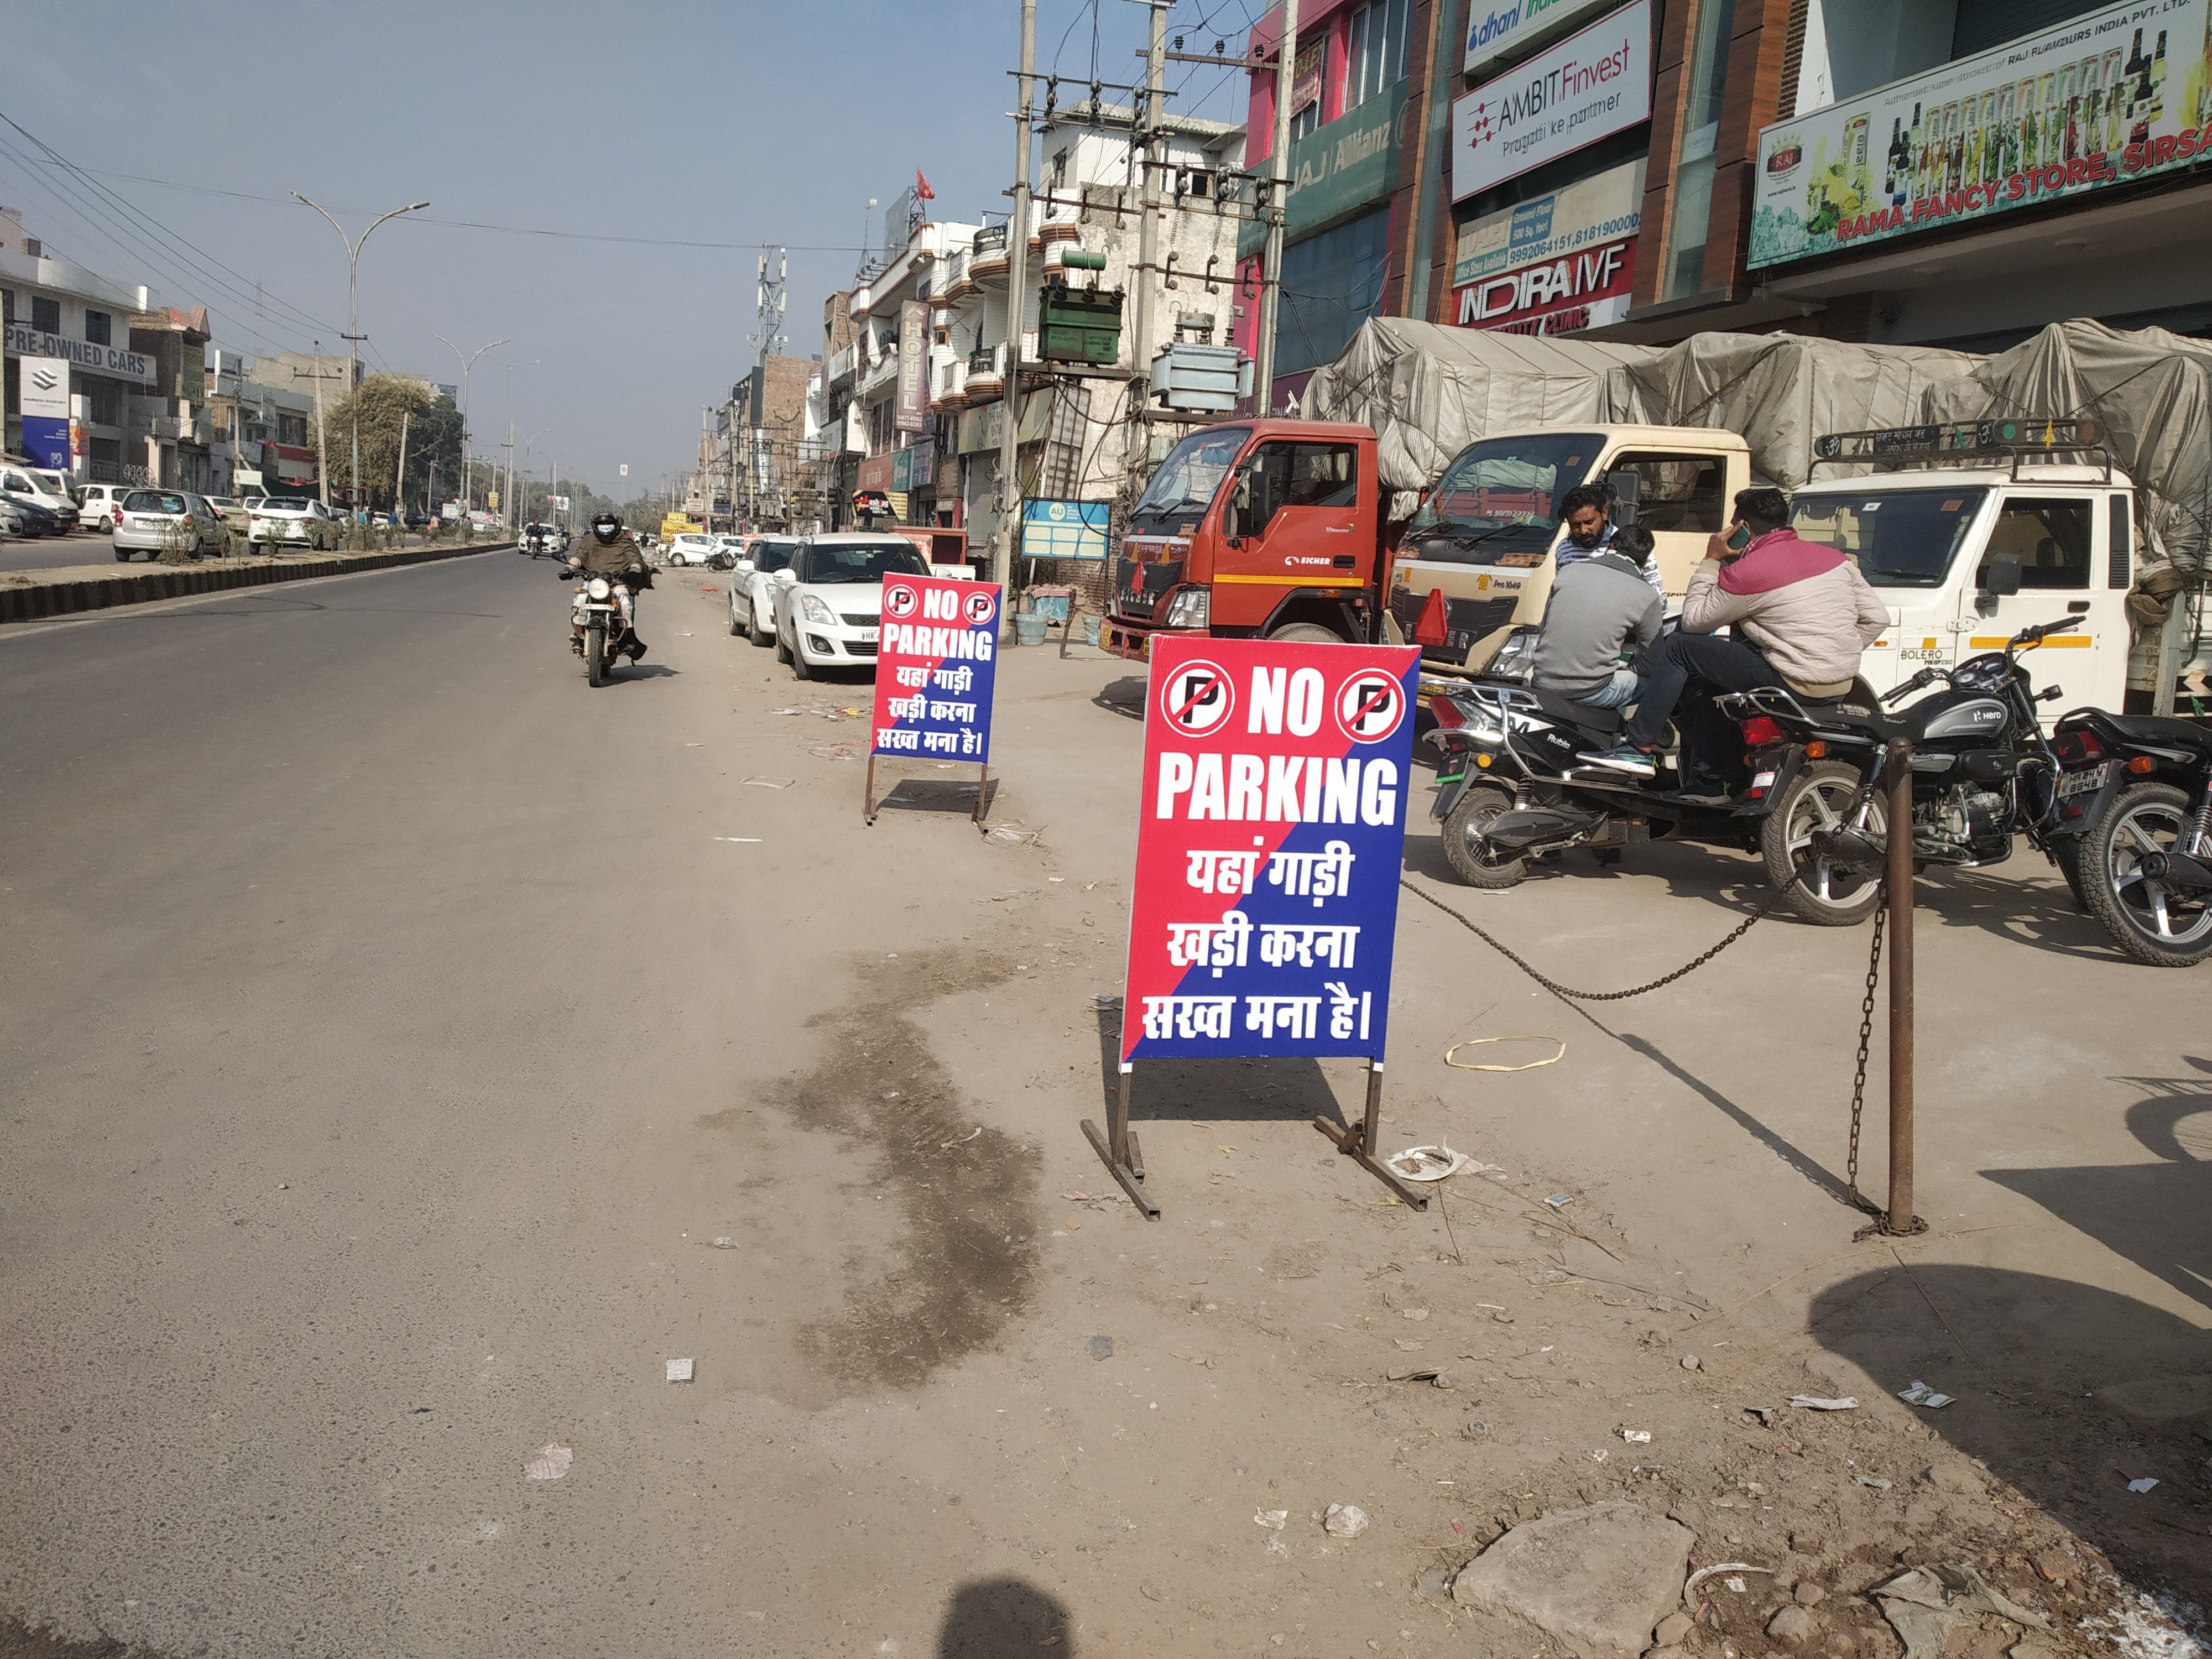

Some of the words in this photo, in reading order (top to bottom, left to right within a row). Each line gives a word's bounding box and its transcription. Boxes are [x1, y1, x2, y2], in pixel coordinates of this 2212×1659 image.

[2008, 48, 2031, 65] RAJ
[2095, 16, 2128, 36] INDIA
[1498, 69, 1561, 132] AMBIT
[1561, 38, 1630, 102] Finvest
[1333, 120, 1392, 175] Allianz
[1551, 119, 1565, 137] ke
[1775, 152, 1794, 168] RAJ
[1837, 205, 1905, 242] RAMA
[1911, 179, 2003, 223] FANCY
[2006, 152, 2116, 201] STORE,
[1458, 260, 1573, 325] INDIRA
[1575, 244, 1627, 295] IVF
[1544, 306, 1588, 333] CLINIC
[108, 349, 145, 374] CARS
[902, 321, 923, 410] HOTEL
[1300, 557, 1331, 565] EICHER
[923, 588, 959, 621] NO
[883, 622, 994, 662] PARKING
[1901, 649, 1943, 660] BOLERO
[896, 661, 932, 688] यहां
[933, 665, 973, 696] गाड़ी
[888, 693, 928, 723] खड़ी
[930, 700, 977, 723] करना
[1247, 666, 1324, 737] NO
[924, 731, 959, 753] मना
[1156, 752, 1399, 826] PARKING
[1186, 836, 1264, 895] यहां
[1268, 839, 1356, 908] गाड़ी
[1166, 910, 1254, 978] खड़ी
[1260, 924, 1361, 969] करना
[1245, 995, 1322, 1039] मना
